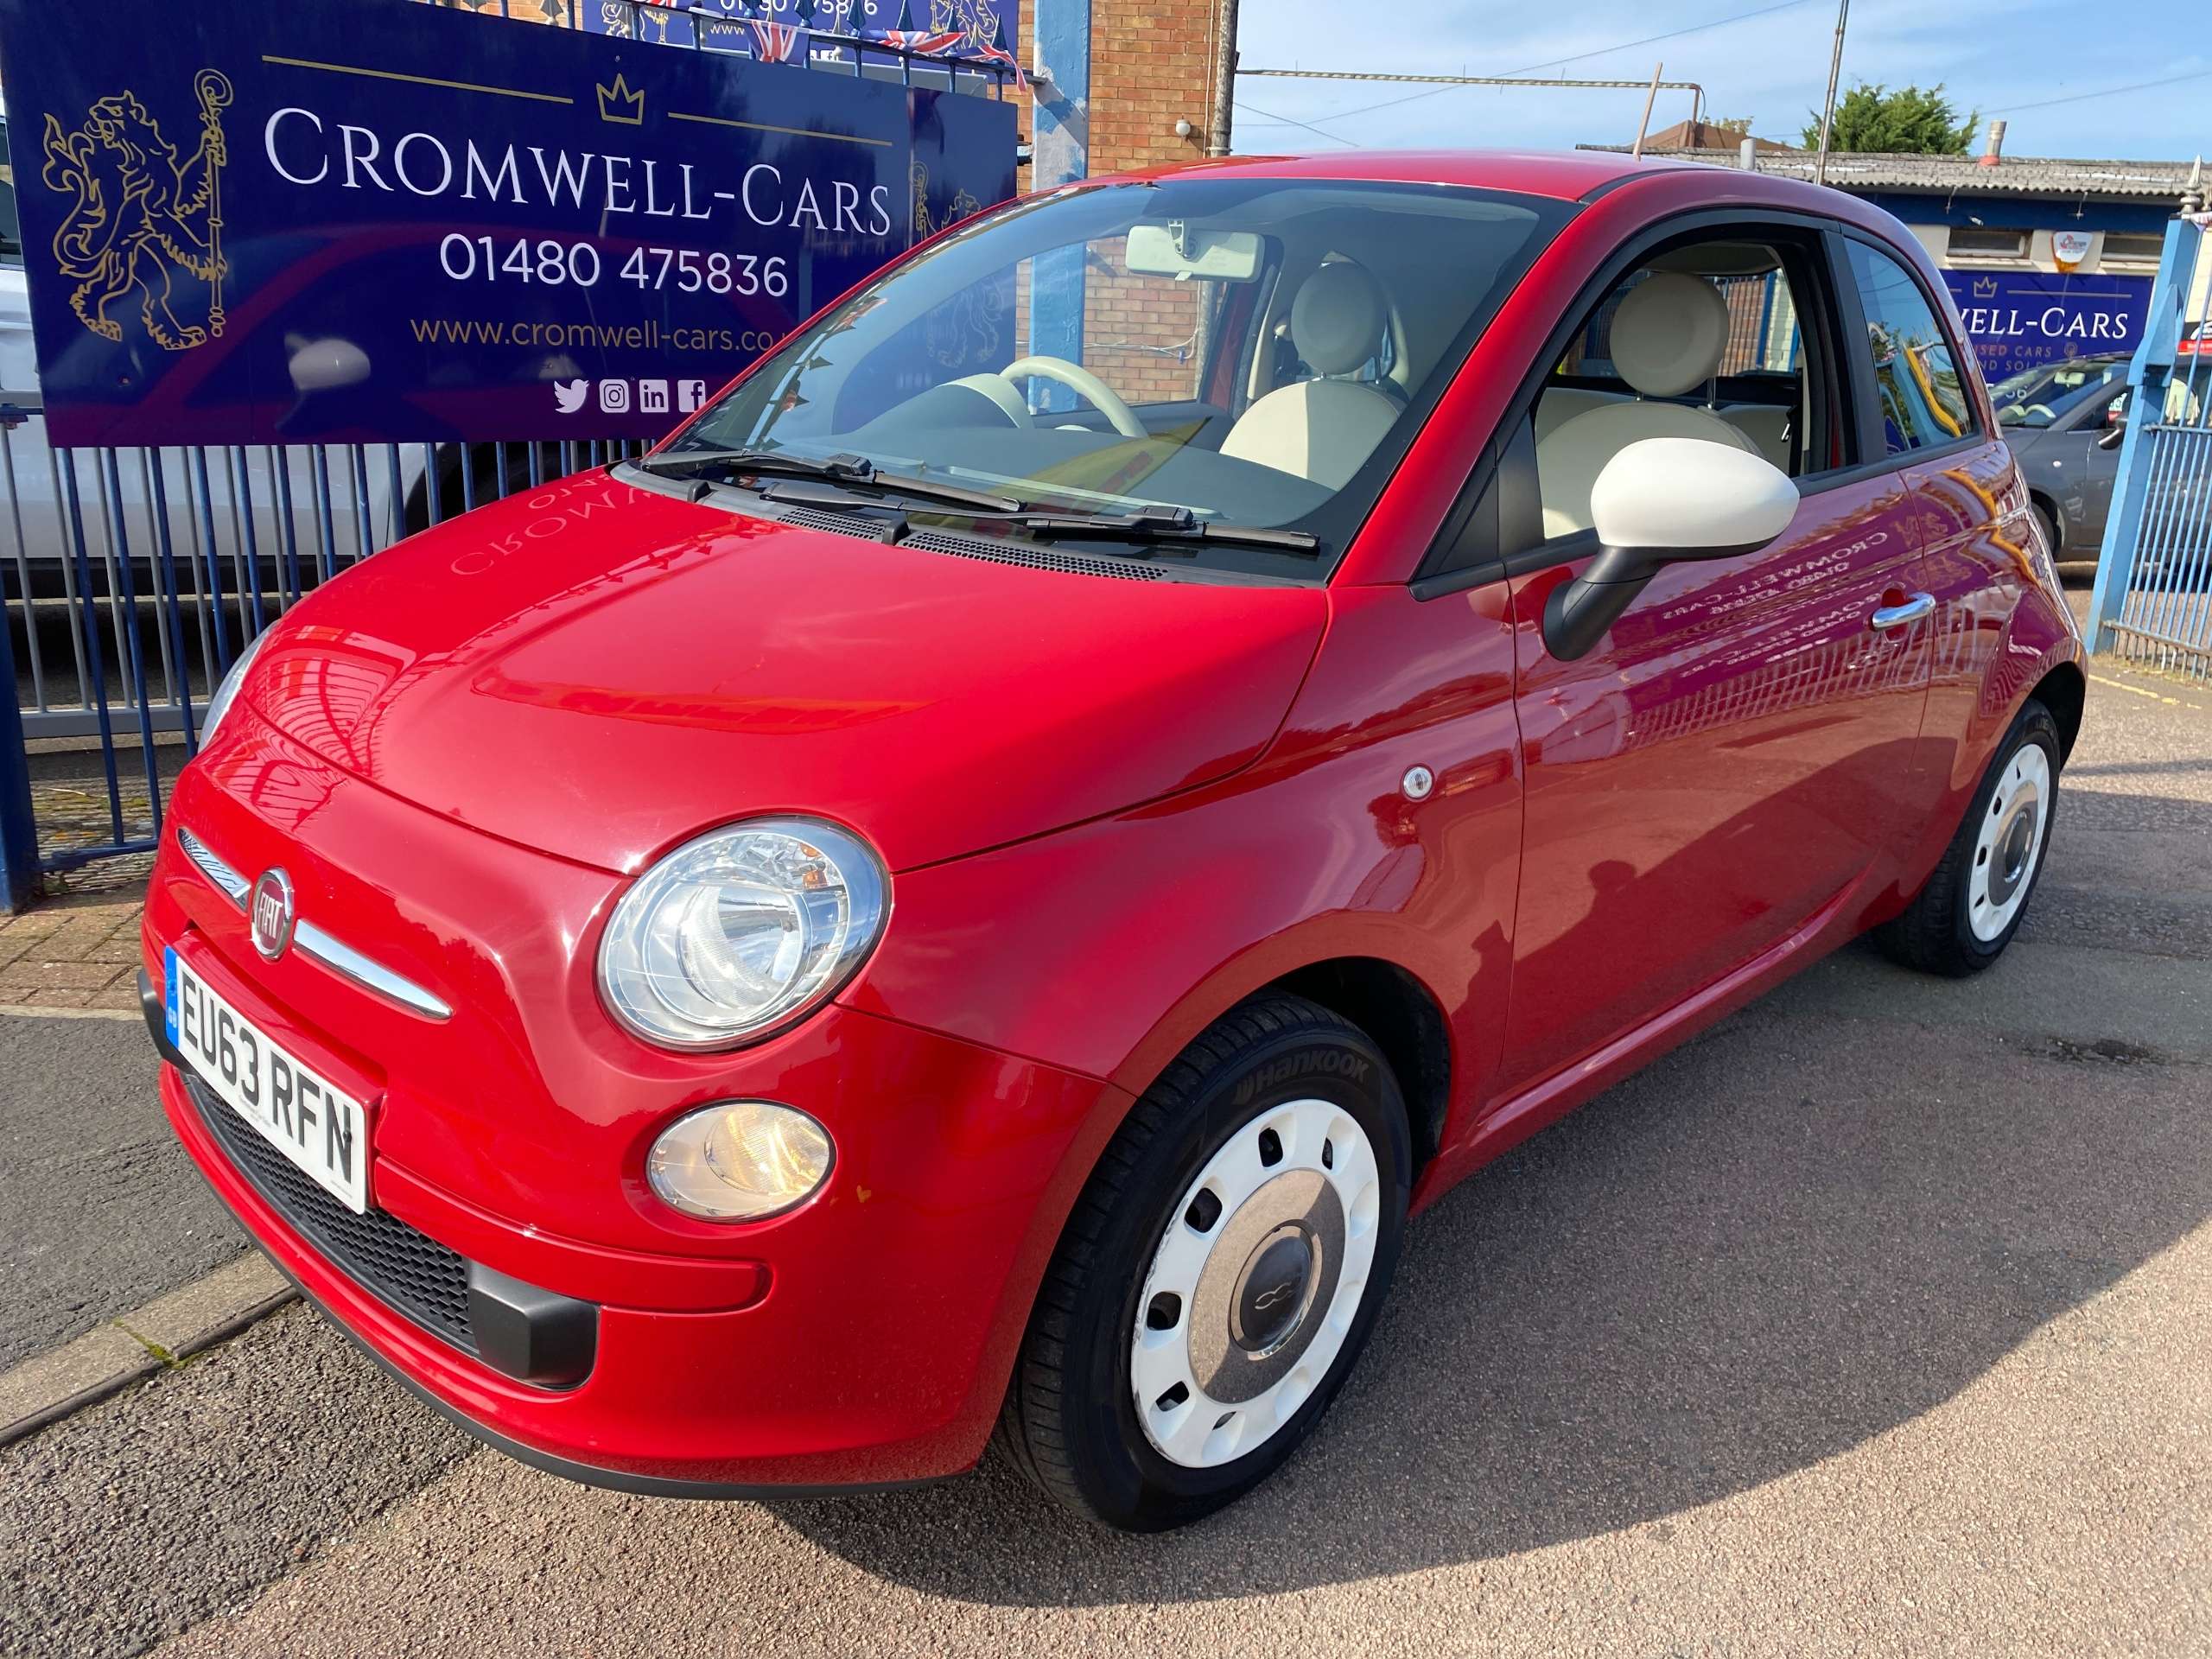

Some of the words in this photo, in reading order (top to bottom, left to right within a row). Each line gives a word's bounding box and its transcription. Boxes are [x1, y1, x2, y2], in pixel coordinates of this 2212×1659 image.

[264, 107, 891, 236] CROMWELL-CARS
[440, 232, 600, 286] 01480
[620, 246, 788, 297] 475836
[410, 319, 785, 351] www.cromwell-cars.co
[2014, 346, 2052, 358] CARS
[258, 891, 283, 939] FIAT
[181, 970, 259, 1107] EU63
[270, 1050, 353, 1185] RFN
